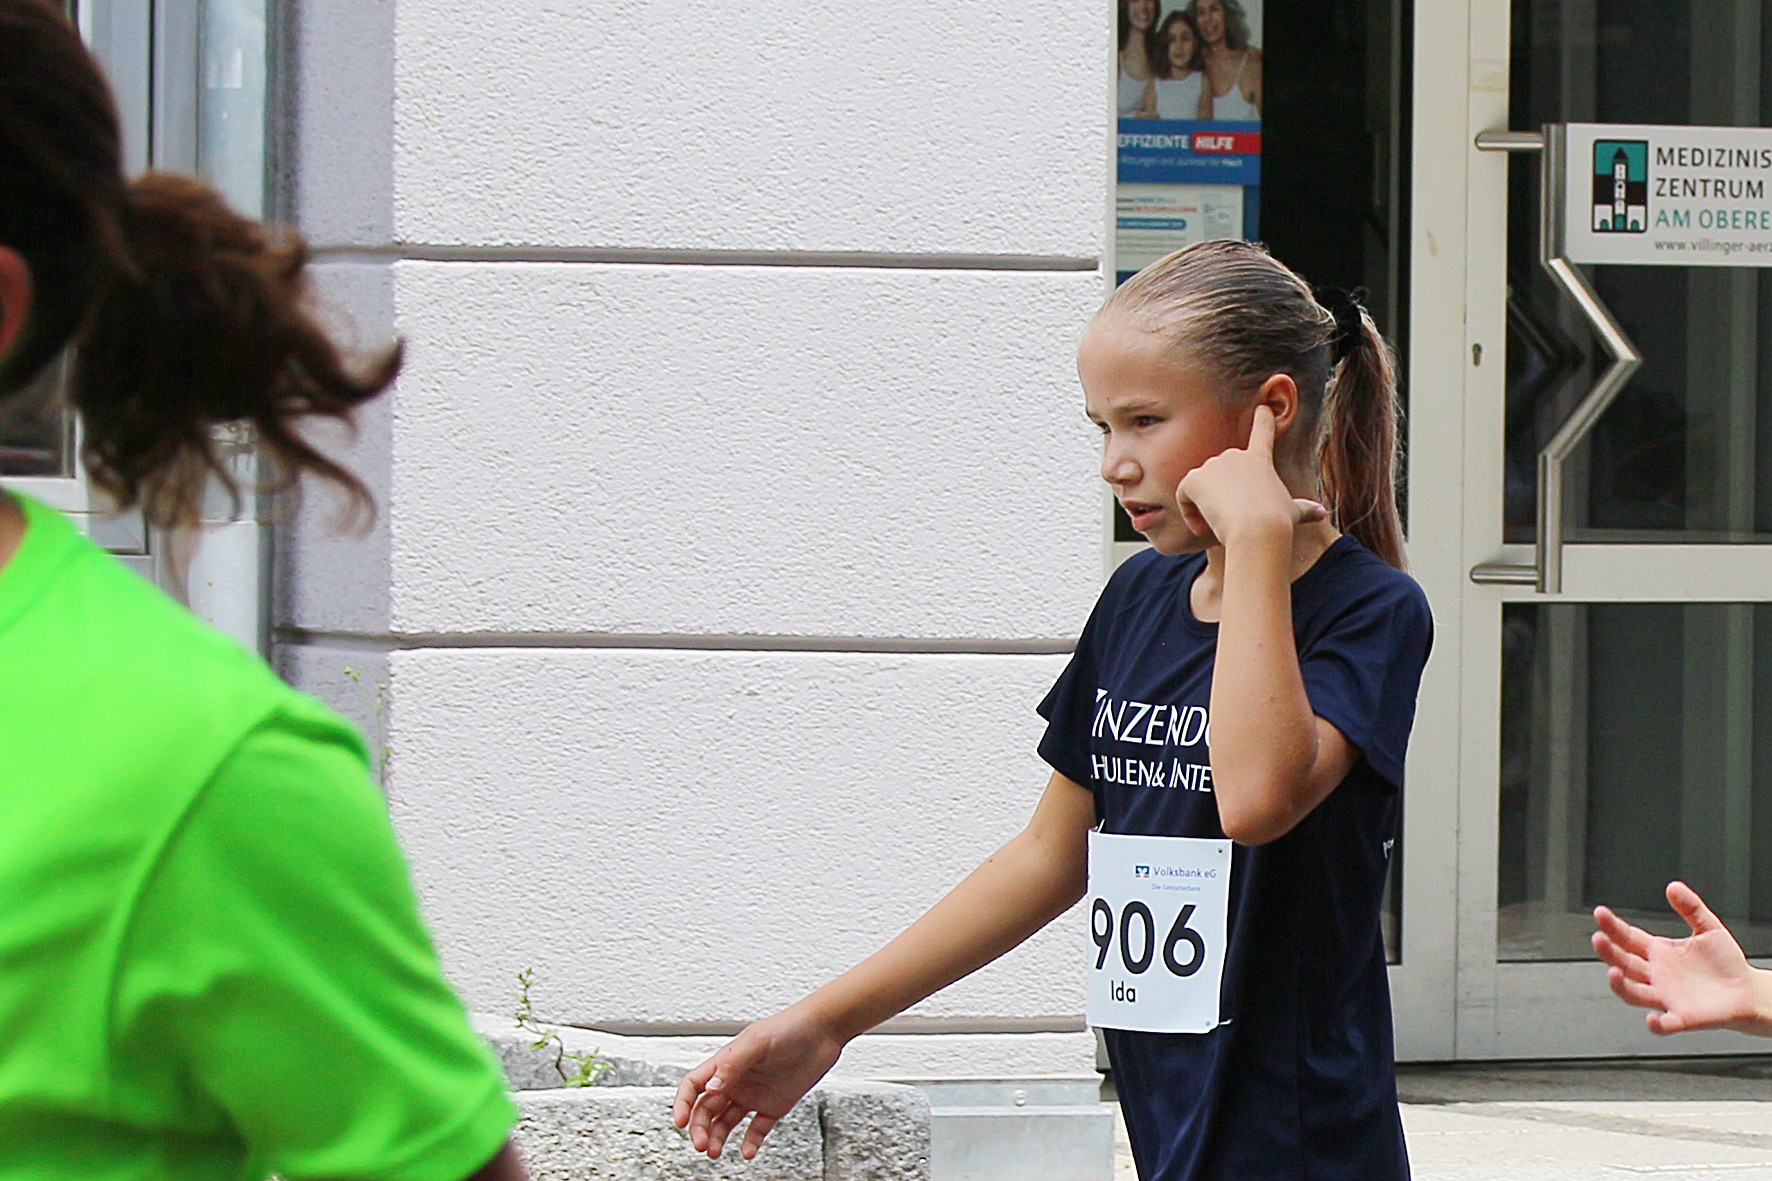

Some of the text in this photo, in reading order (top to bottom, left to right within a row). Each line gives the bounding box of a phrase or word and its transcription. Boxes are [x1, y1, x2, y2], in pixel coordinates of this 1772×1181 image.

[1195, 135, 1235, 150] HILFE
[1655, 178, 1764, 199] ZENTRUM
[1655, 209, 1691, 229] AM
[1092, 688, 1210, 747] INZEND
[1169, 757, 1212, 793] INTE
[1153, 866, 1217, 879] Volksbank eG
[1091, 898, 1206, 978] 906
[1110, 980, 1136, 1003] Ida
